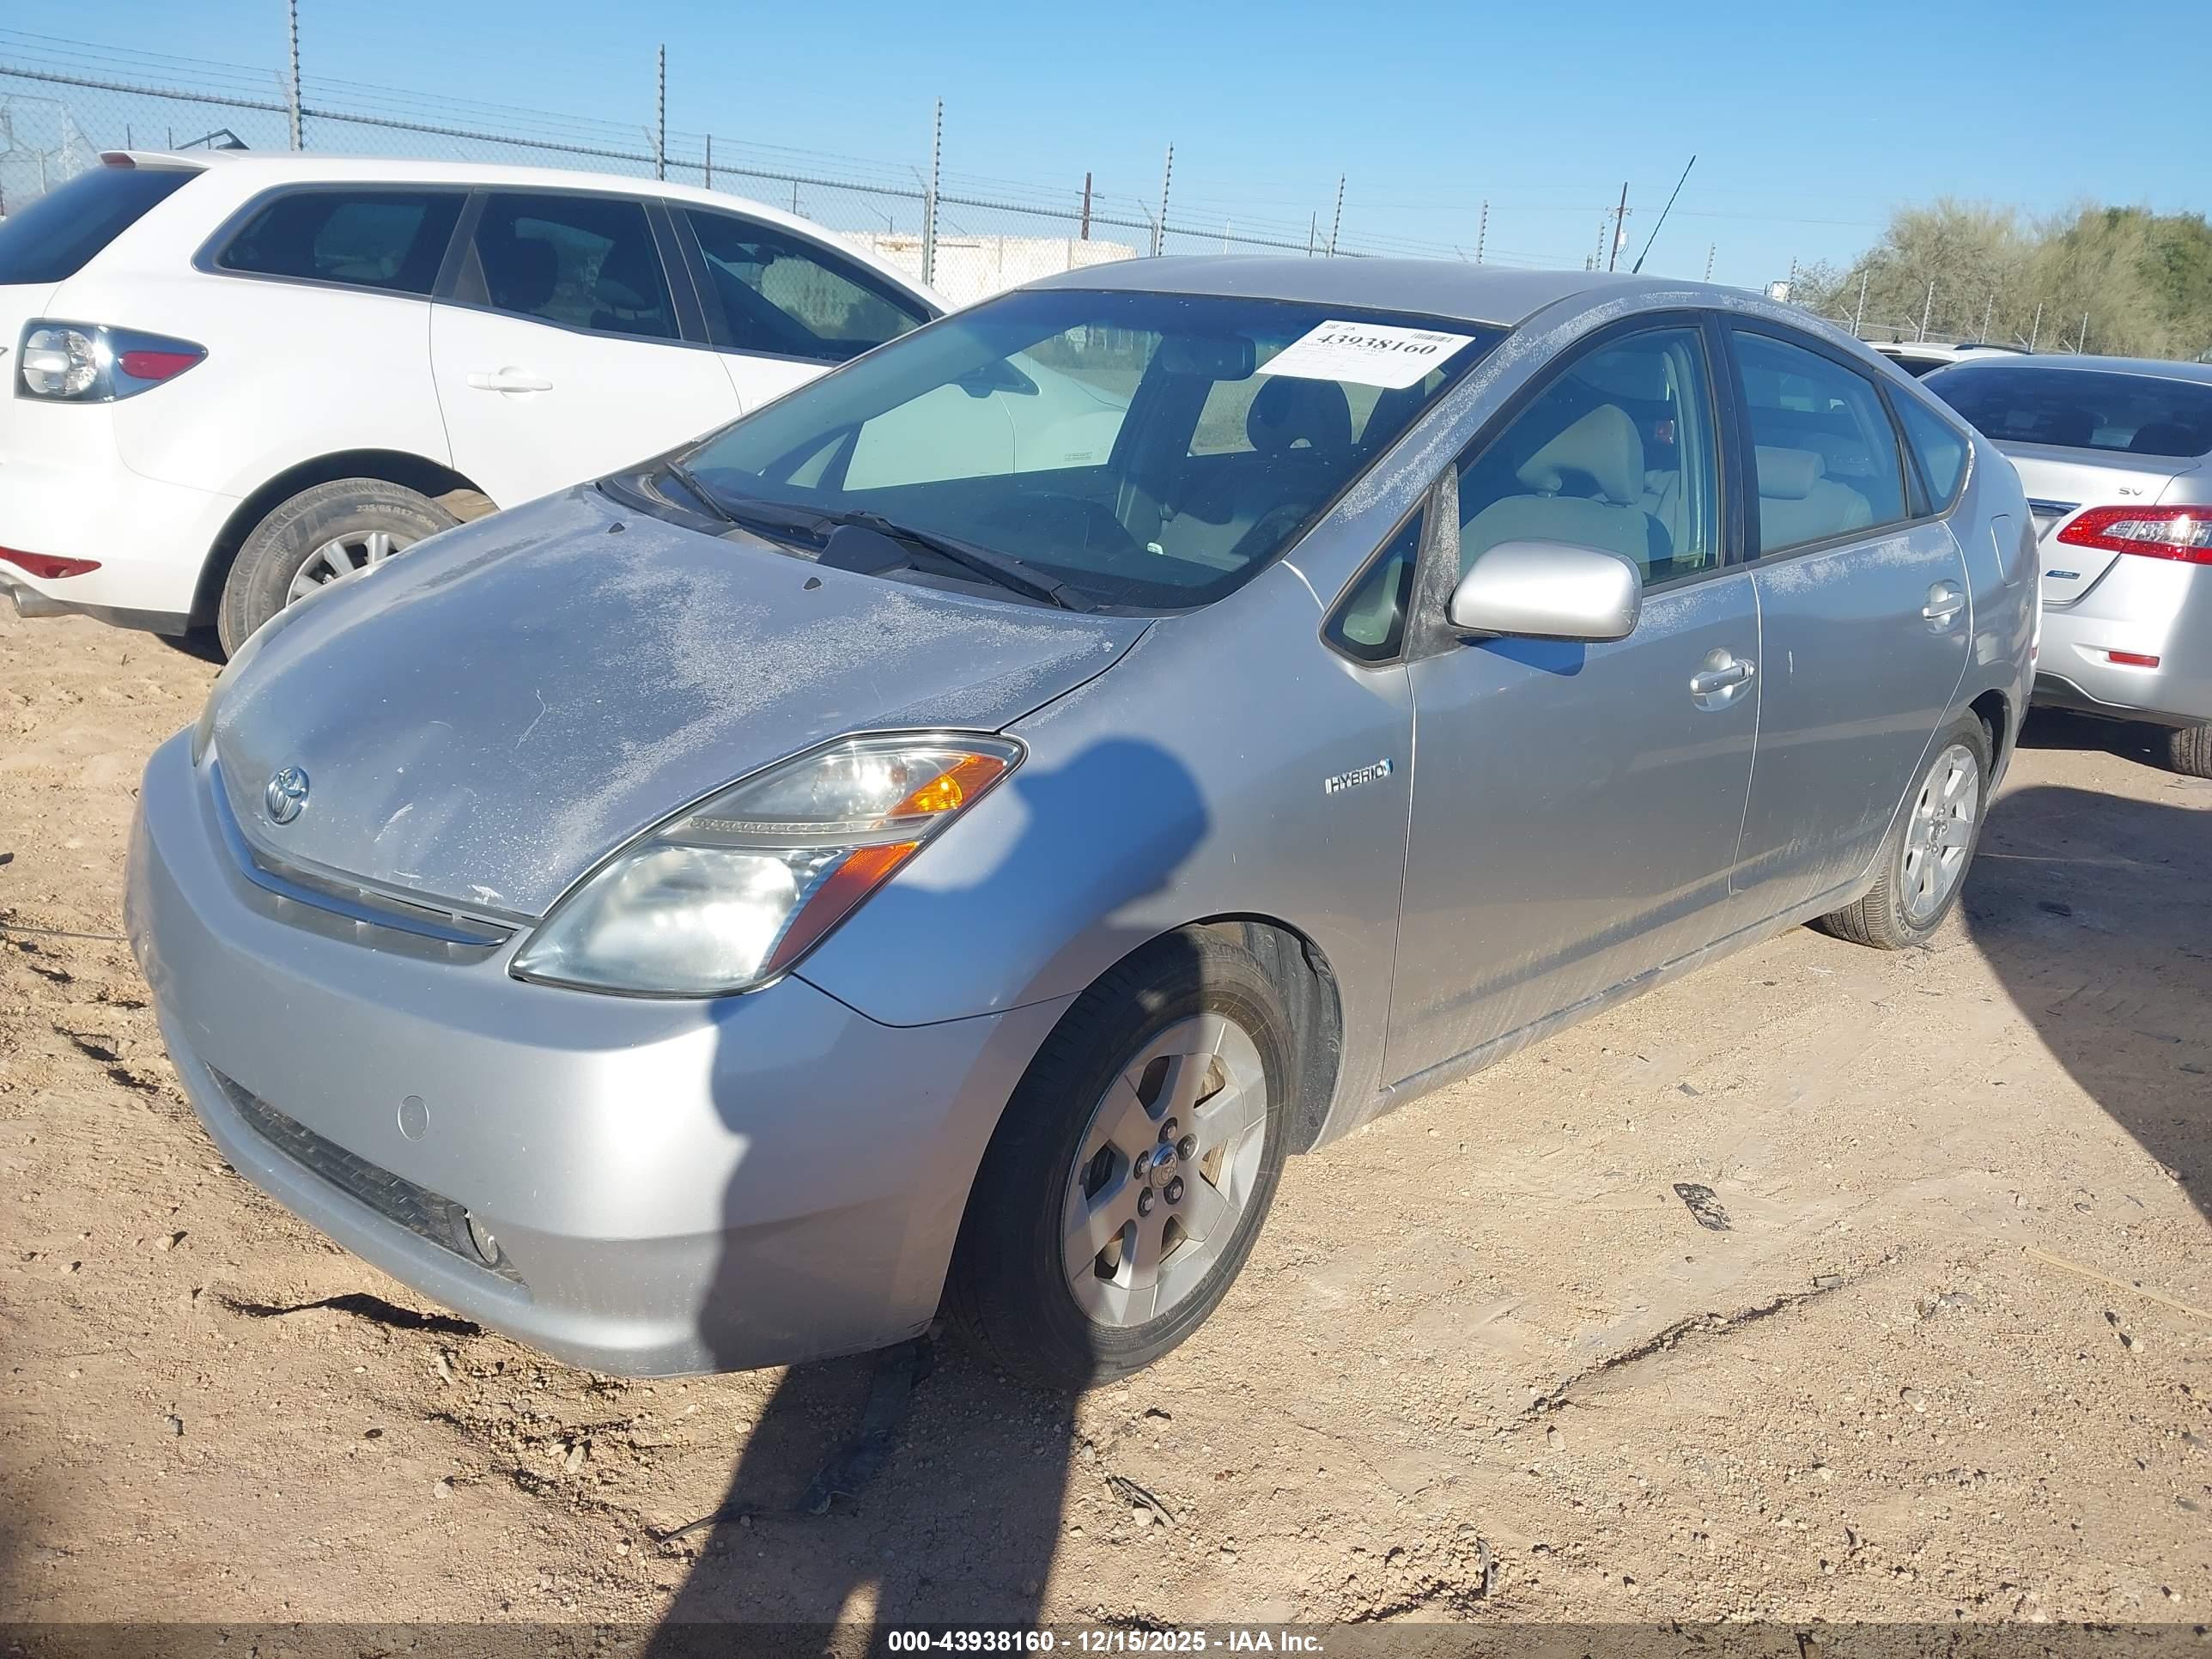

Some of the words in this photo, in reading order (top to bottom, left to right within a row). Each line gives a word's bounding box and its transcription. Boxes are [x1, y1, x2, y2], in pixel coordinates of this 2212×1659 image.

[1316, 332, 1438, 356] 43938160
[2118, 486, 2144, 496] SV
[1330, 763, 1385, 793] HYBRID
